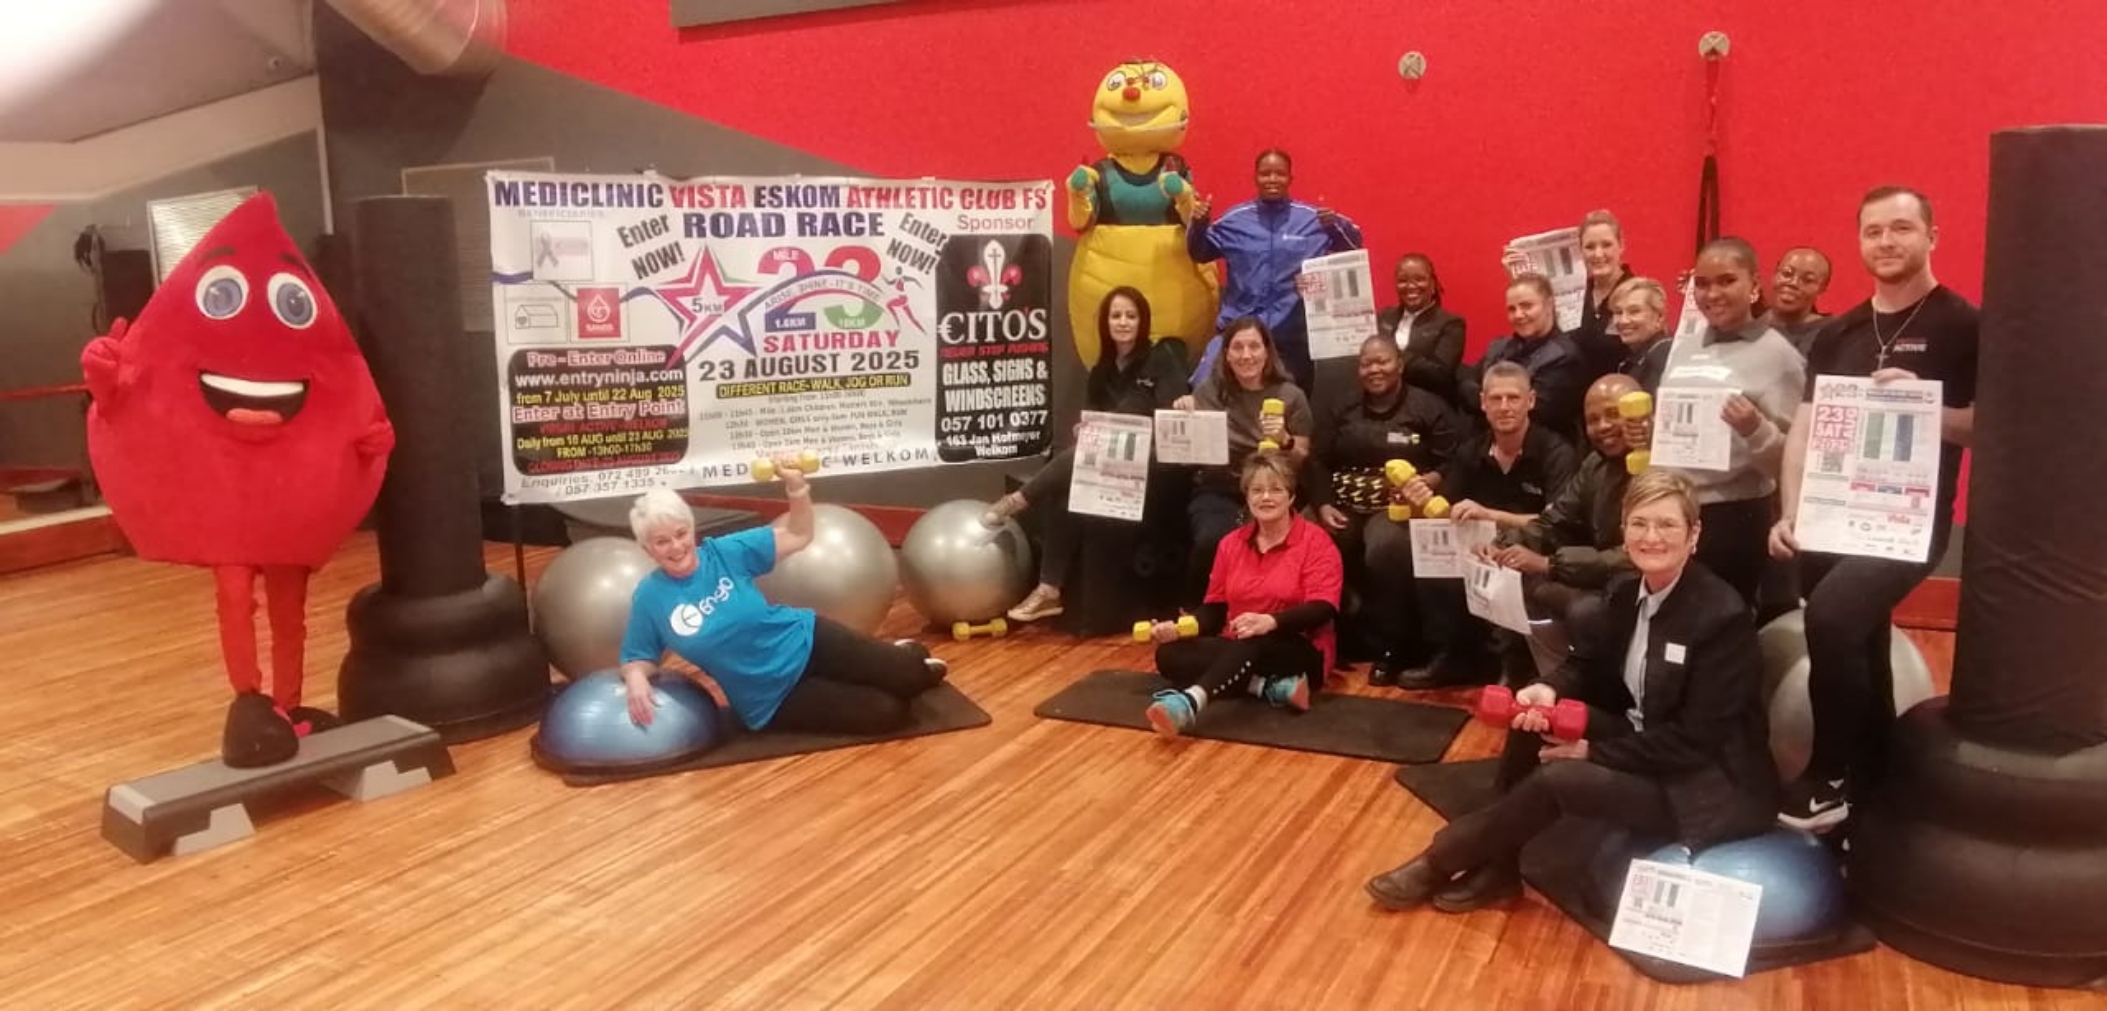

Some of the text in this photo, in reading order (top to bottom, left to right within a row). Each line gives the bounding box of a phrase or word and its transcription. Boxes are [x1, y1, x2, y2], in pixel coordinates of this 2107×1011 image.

[494, 181, 1047, 210] MEDICLINIC VISTA ESKOM ATHLETIC CLUB FS
[616, 214, 670, 249] Enter
[683, 212, 885, 239] ROAD RACE
[899, 212, 949, 249] Enter
[957, 214, 1035, 233] Sponsor
[631, 241, 686, 280] NOW!
[886, 237, 941, 275] NOW!
[763, 331, 900, 353] SATURDAY
[699, 350, 920, 381] 23 AUGUST 2025
[942, 357, 1048, 386] GLASS, SIGNS &
[515, 368, 684, 388] www.entryninja.com
[718, 382, 778, 397] DIFFERENT
[845, 375, 867, 389] JOG
[869, 374, 884, 388] OR
[885, 373, 909, 387] RUN
[516, 384, 686, 405] from 7 July until 22 Aug 2025
[944, 383, 1046, 413] WINDSCREENS
[512, 399, 687, 424] Enter at Entry Point
[941, 410, 1048, 432] 057 101 0377
[1818, 406, 1844, 422] 23
[517, 437, 541, 451] Daily
[542, 435, 565, 447] from
[581, 433, 604, 446] AUG
[606, 430, 627, 442] until
[642, 428, 664, 441] AUG
[969, 433, 990, 446] Jan
[1816, 422, 1843, 437] SAT
[556, 446, 587, 459] FROM
[975, 443, 1018, 457] Welkom
